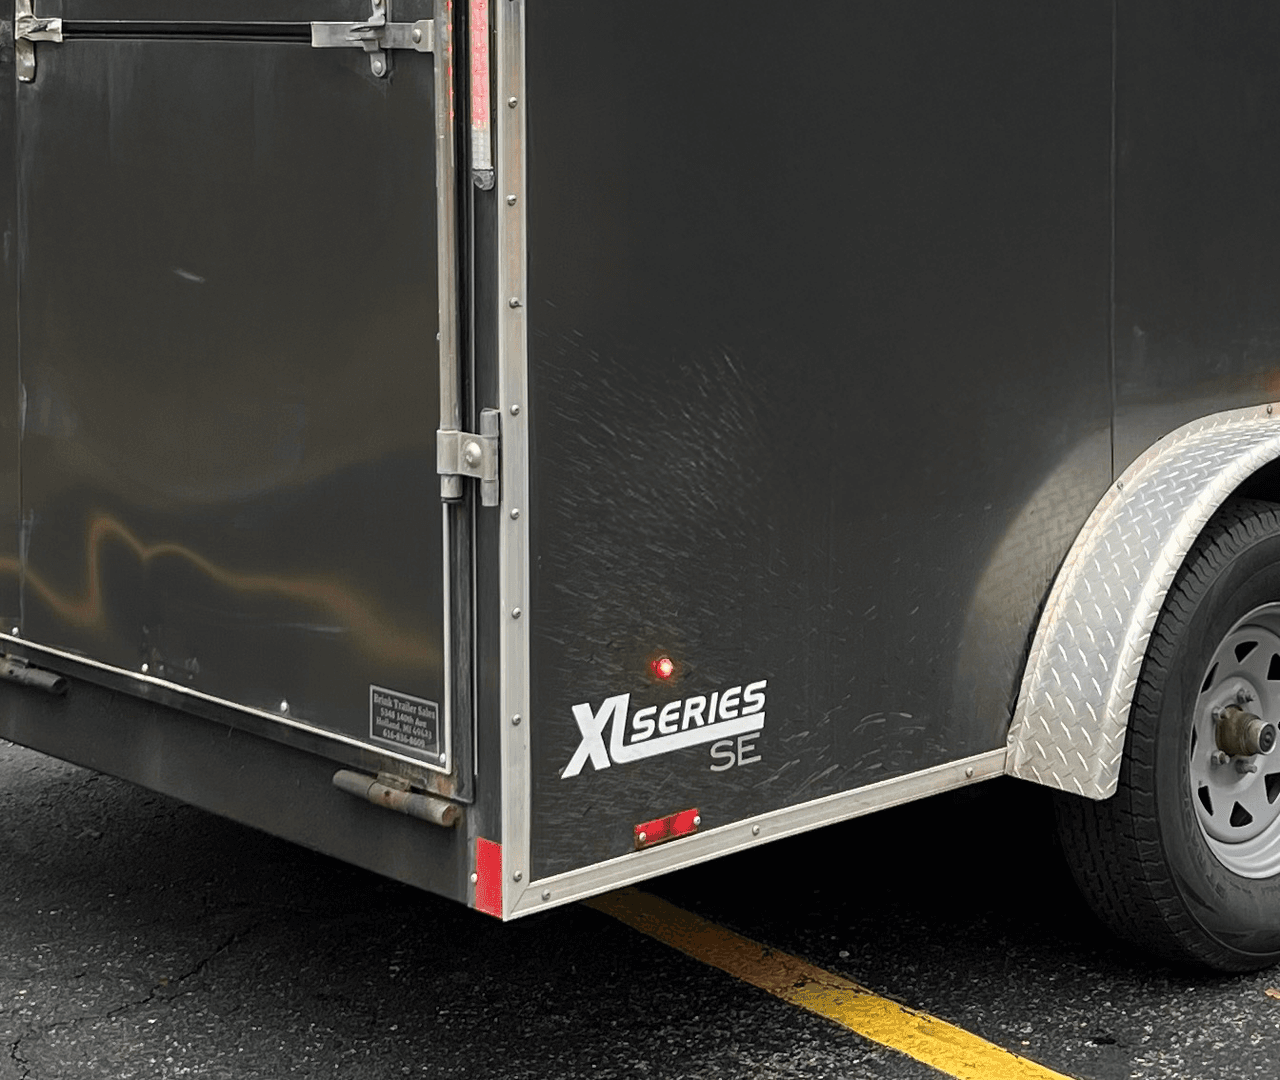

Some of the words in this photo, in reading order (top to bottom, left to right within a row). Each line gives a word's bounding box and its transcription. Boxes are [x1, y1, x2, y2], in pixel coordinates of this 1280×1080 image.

[374, 693, 393, 707] Brink
[394, 699, 417, 714] Trailer
[630, 680, 768, 743] SERIES
[709, 731, 762, 772] SE
